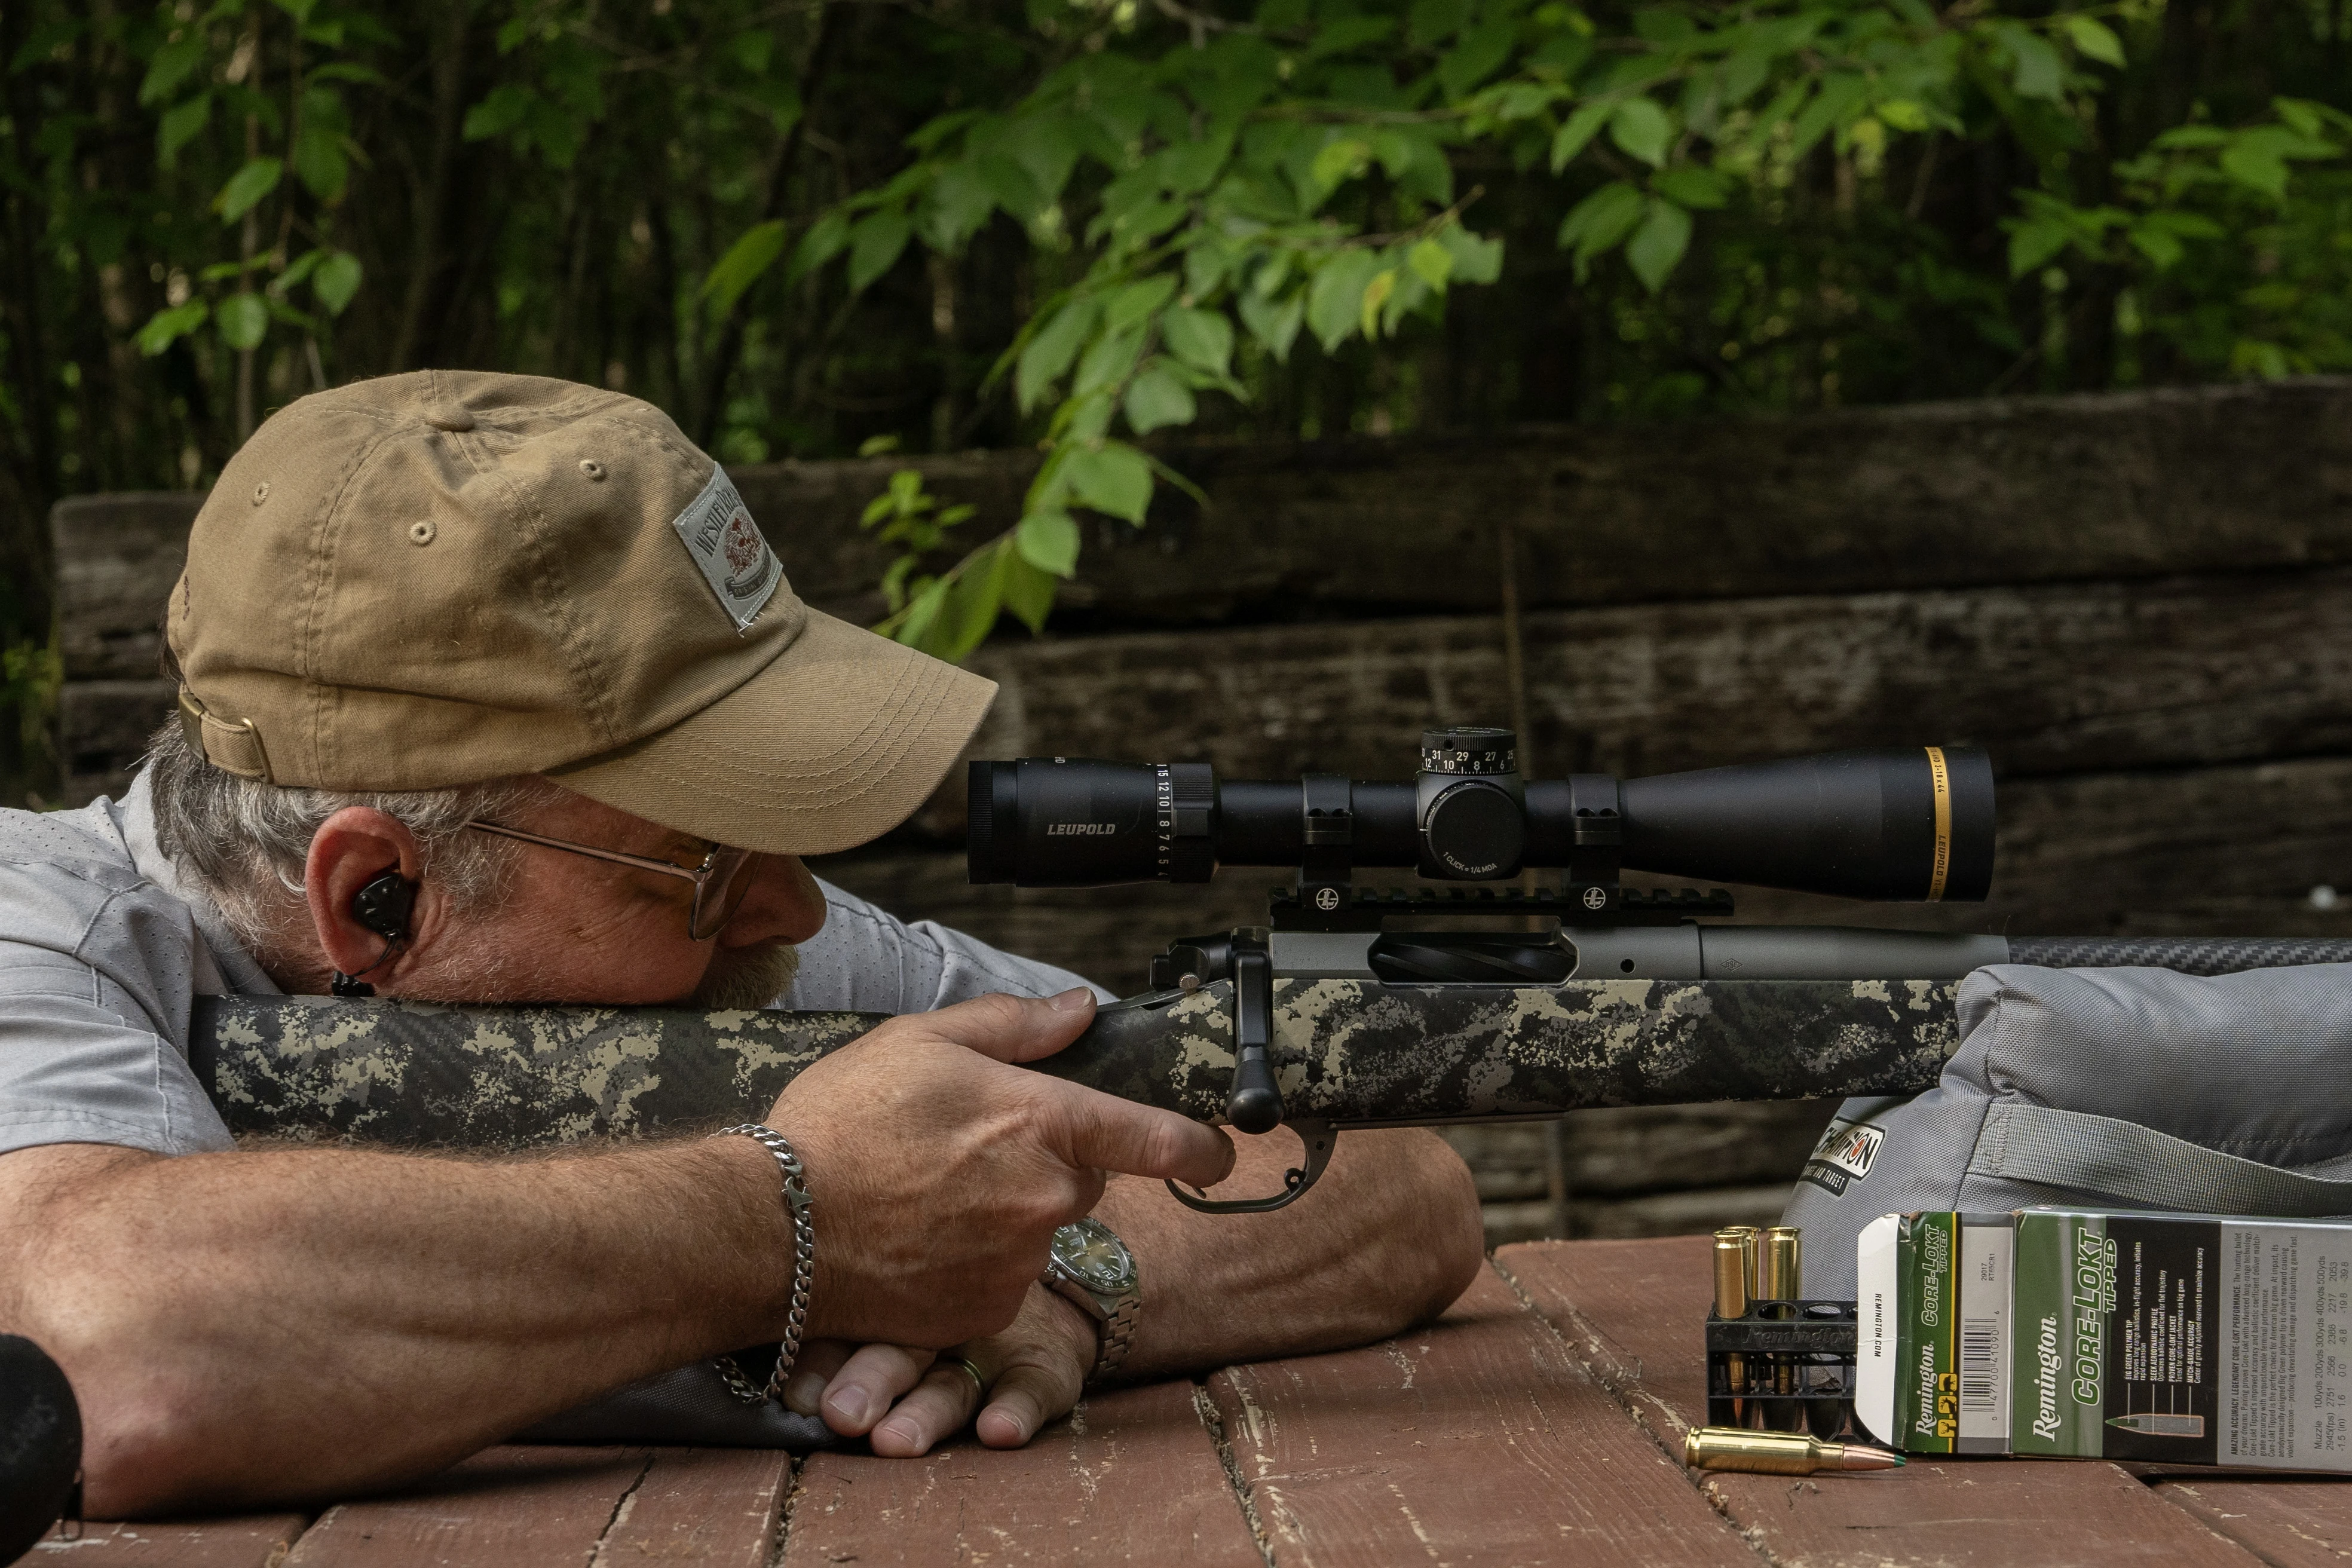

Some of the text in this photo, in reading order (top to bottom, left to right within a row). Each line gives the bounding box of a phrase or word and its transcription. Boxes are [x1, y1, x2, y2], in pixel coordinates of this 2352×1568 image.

[1425, 758, 1504, 770] 12 10 8 6
[1432, 750, 1441, 760] 31
[1457, 752, 1469, 761] 29
[1486, 752, 1496, 761] 27
[1159, 782, 1169, 791] 12
[1159, 796, 1169, 807] 10
[1047, 823, 1115, 835] LEUPOLD
[1447, 856, 1465, 871] CLICK
[1481, 863, 1497, 872] MOA
[1937, 835, 1946, 876] LEUPOLD
[1823, 1169, 1845, 1189] TARGET
[1939, 1230, 1948, 1273] TIPPED
[2234, 1250, 2243, 1272] hunting
[2244, 1232, 2252, 1263] technology,
[1922, 1224, 1938, 1327] CORE-LOKT
[2104, 1239, 2117, 1313] TIPPED
[2243, 1265, 2252, 1296] long-range
[2289, 1267, 2298, 1300] dispatching
[2071, 1227, 2103, 1406] CORE-LOKT
[2232, 1285, 2241, 1328] PERFORMANCE.
[1874, 1293, 1882, 1357] REMINGTON.COM
[2289, 1315, 2297, 1337] damage
[2328, 1324, 2336, 1345] 2388
[2288, 1339, 2296, 1372] devastating
[2314, 1255, 2326, 1449] Muzzle 100yds 200yds 300yds 400yds 500yds
[2328, 1356, 2336, 1376] 2566
[2034, 1318, 2062, 1442] Remington
[2259, 1353, 2268, 1397] unquestionable
[2278, 1375, 2286, 1384] Big
[2287, 1374, 2296, 1402] producing
[1916, 1345, 1937, 1437] Remington
[2241, 1391, 2249, 1410] Pairing
[2277, 1386, 2286, 1411] designed
[2327, 1388, 2335, 1407] 2751
[2277, 1413, 2286, 1457] aerodynamically
